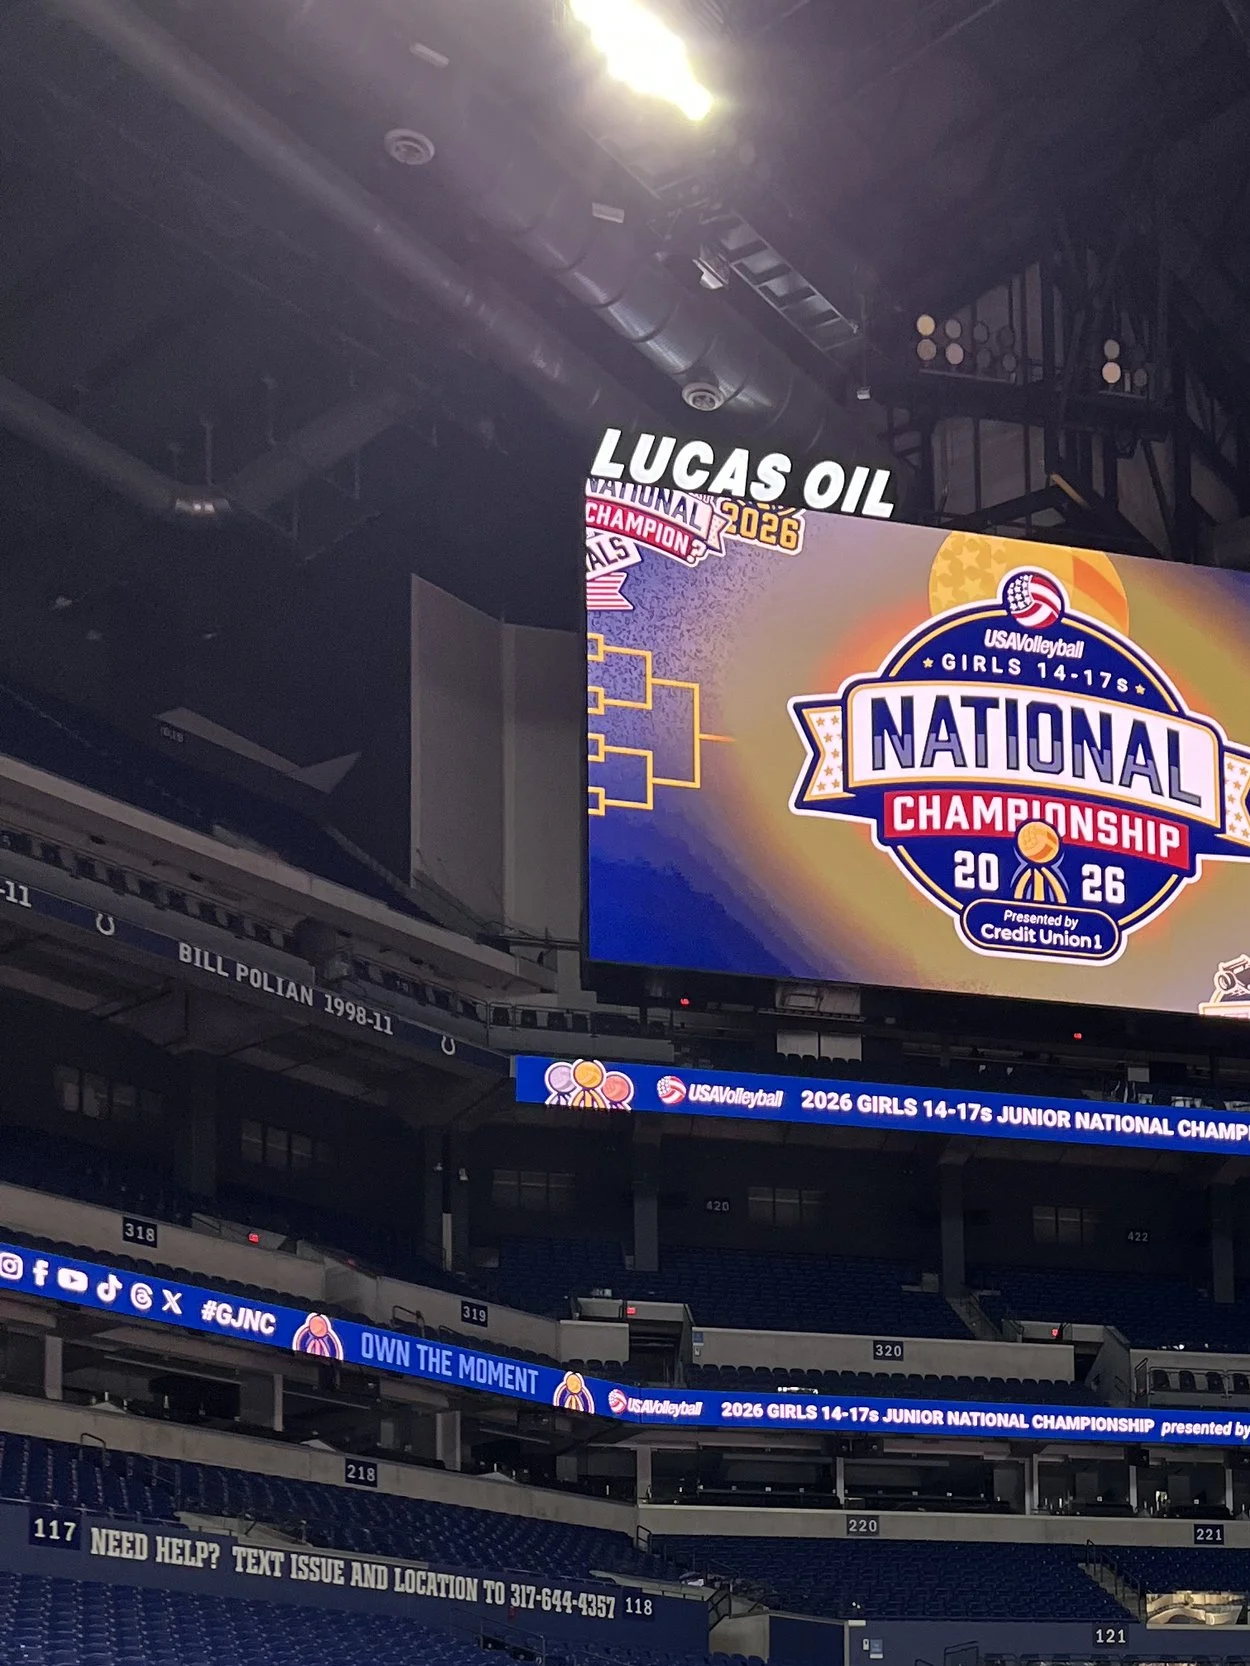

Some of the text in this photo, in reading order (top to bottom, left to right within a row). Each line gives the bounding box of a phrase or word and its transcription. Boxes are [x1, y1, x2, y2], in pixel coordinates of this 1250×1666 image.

[590, 428, 896, 518] LUCAS OIL
[721, 502, 801, 550] 2026
[942, 653, 1129, 693] GIRLS 14-17s
[870, 694, 1203, 809] NATIONAL
[892, 795, 1182, 859] CHAMPIONSHIP
[953, 850, 1126, 905] 20 26
[1004, 909, 1079, 931] Presented by
[981, 922, 1037, 945] Credit
[178, 941, 393, 1035] BILL POLIAN 1998-11
[801, 1089, 853, 1112] 2026
[857, 1093, 918, 1117] GIRLS
[923, 1099, 993, 1123] 14-17s
[997, 1105, 1071, 1129] JUNIOR
[1075, 1112, 1174, 1137] NATIONAL
[706, 1200, 730, 1212] 420
[124, 1222, 156, 1244] 318
[1127, 1230, 1149, 1243] 422
[201, 1299, 277, 1336] #GJNC
[462, 1304, 488, 1323] 319
[361, 1331, 539, 1395] OWN THE MOMENT
[875, 1343, 902, 1358] 320
[721, 1402, 764, 1419] 2026
[767, 1403, 818, 1421] GIRLS
[821, 1405, 879, 1423] 14-17s
[882, 1408, 944, 1426] JUNIOR
[947, 1410, 1029, 1430] NATIONAL
[1031, 1413, 1155, 1434] CHAMPIONSHIP
[1161, 1419, 1233, 1438] presented
[346, 1463, 376, 1483] 218
[33, 1518, 76, 1543] 117
[848, 1519, 878, 1533] 220
[1196, 1528, 1223, 1542] 221
[90, 1526, 616, 1619] NEED HELP? TEXT ISSUE AND LOCATION TO 317-644-4357
[625, 1596, 653, 1617] 118
[1096, 1629, 1126, 1644] 121
